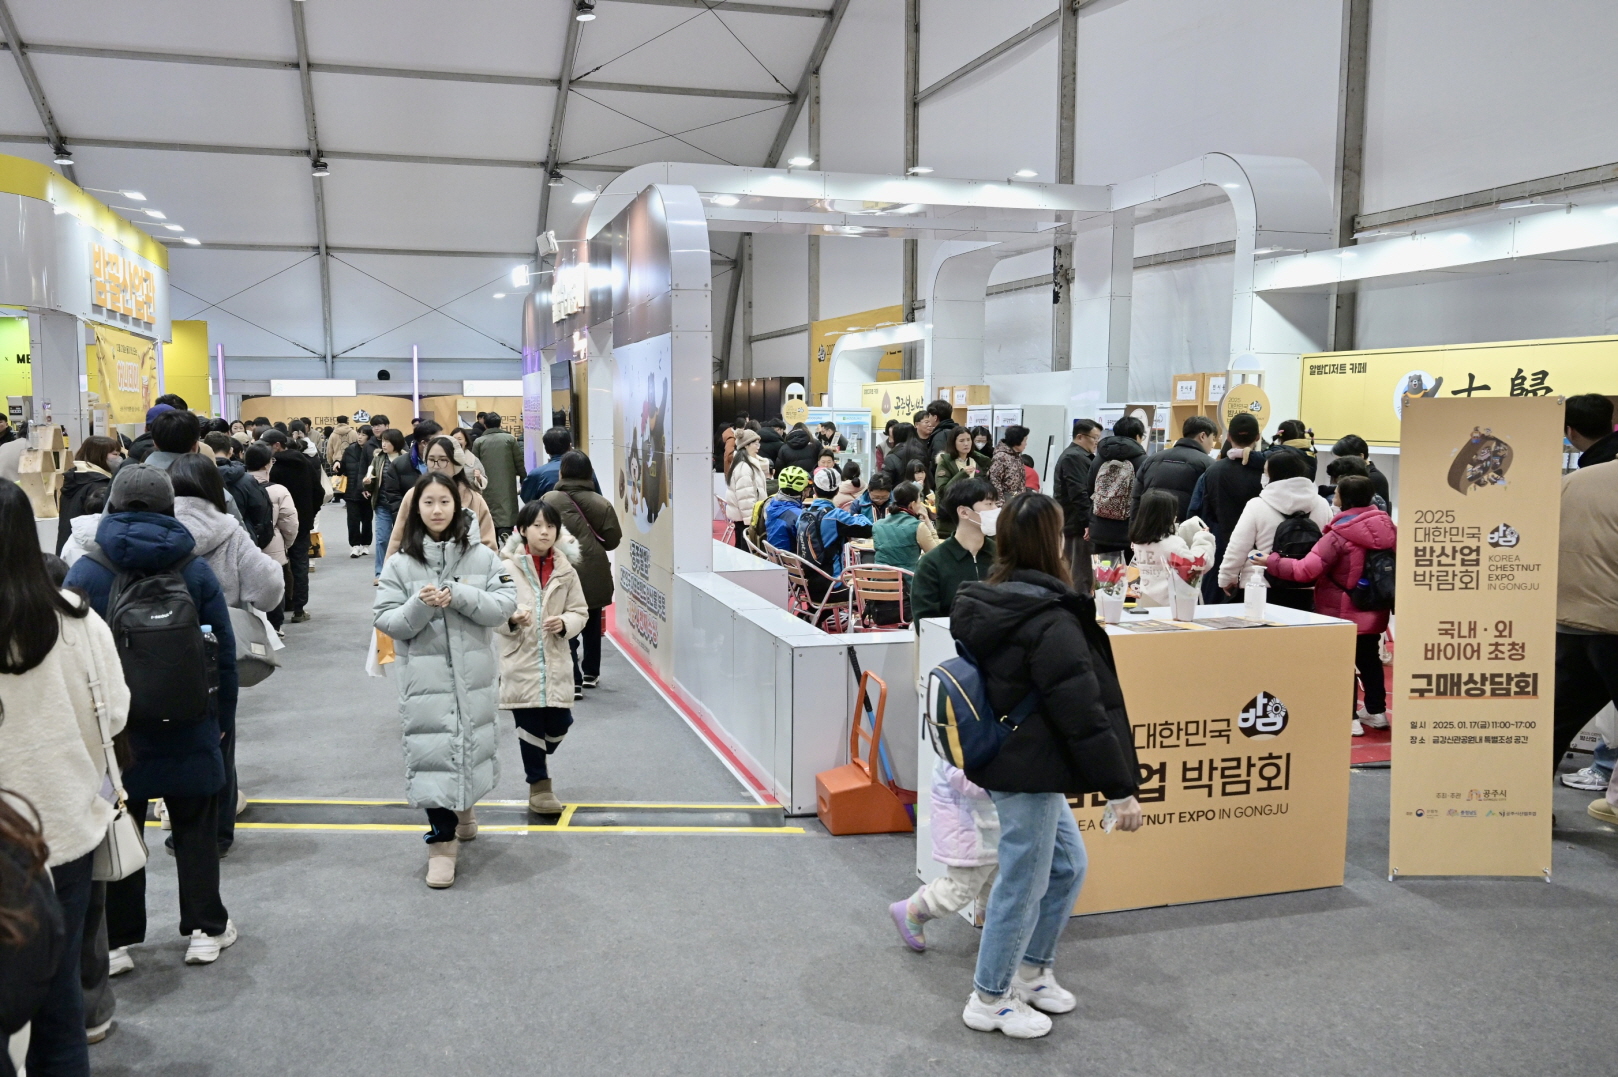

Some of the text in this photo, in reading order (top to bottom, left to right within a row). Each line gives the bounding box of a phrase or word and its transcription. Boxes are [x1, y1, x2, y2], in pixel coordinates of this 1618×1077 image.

[1309, 361, 1367, 376] 알밤디저트 카페
[1414, 509, 1456, 524] 2025
[1414, 526, 1482, 543] 대한민국
[1414, 545, 1481, 568] 밤산업
[1488, 554, 1521, 563] KOREA
[1488, 563, 1542, 572] CHESTNUT
[1413, 569, 1480, 591] 박람회
[1487, 573, 1515, 582] EXPO
[1487, 582, 1540, 591] IN GONGJU
[1437, 620, 1513, 640] 국내 외
[1423, 641, 1526, 662] 바이어 초청
[1409, 672, 1539, 698] 구매상담회
[1432, 721, 1456, 729] 2025.
[1457, 721, 1468, 729] 01.
[1469, 720, 1491, 730] 17(금)
[1491, 721, 1537, 729] 11:00~17:00
[1132, 718, 1232, 750] 대한민국
[1484, 735, 1513, 744] 특별조성
[1514, 735, 1529, 744] 공간
[1181, 752, 1291, 798] 박람회
[1482, 789, 1507, 798] 공주시
[1178, 808, 1216, 823] EXPO
[1218, 807, 1231, 821] IN
[1234, 802, 1289, 819] GONGJU
